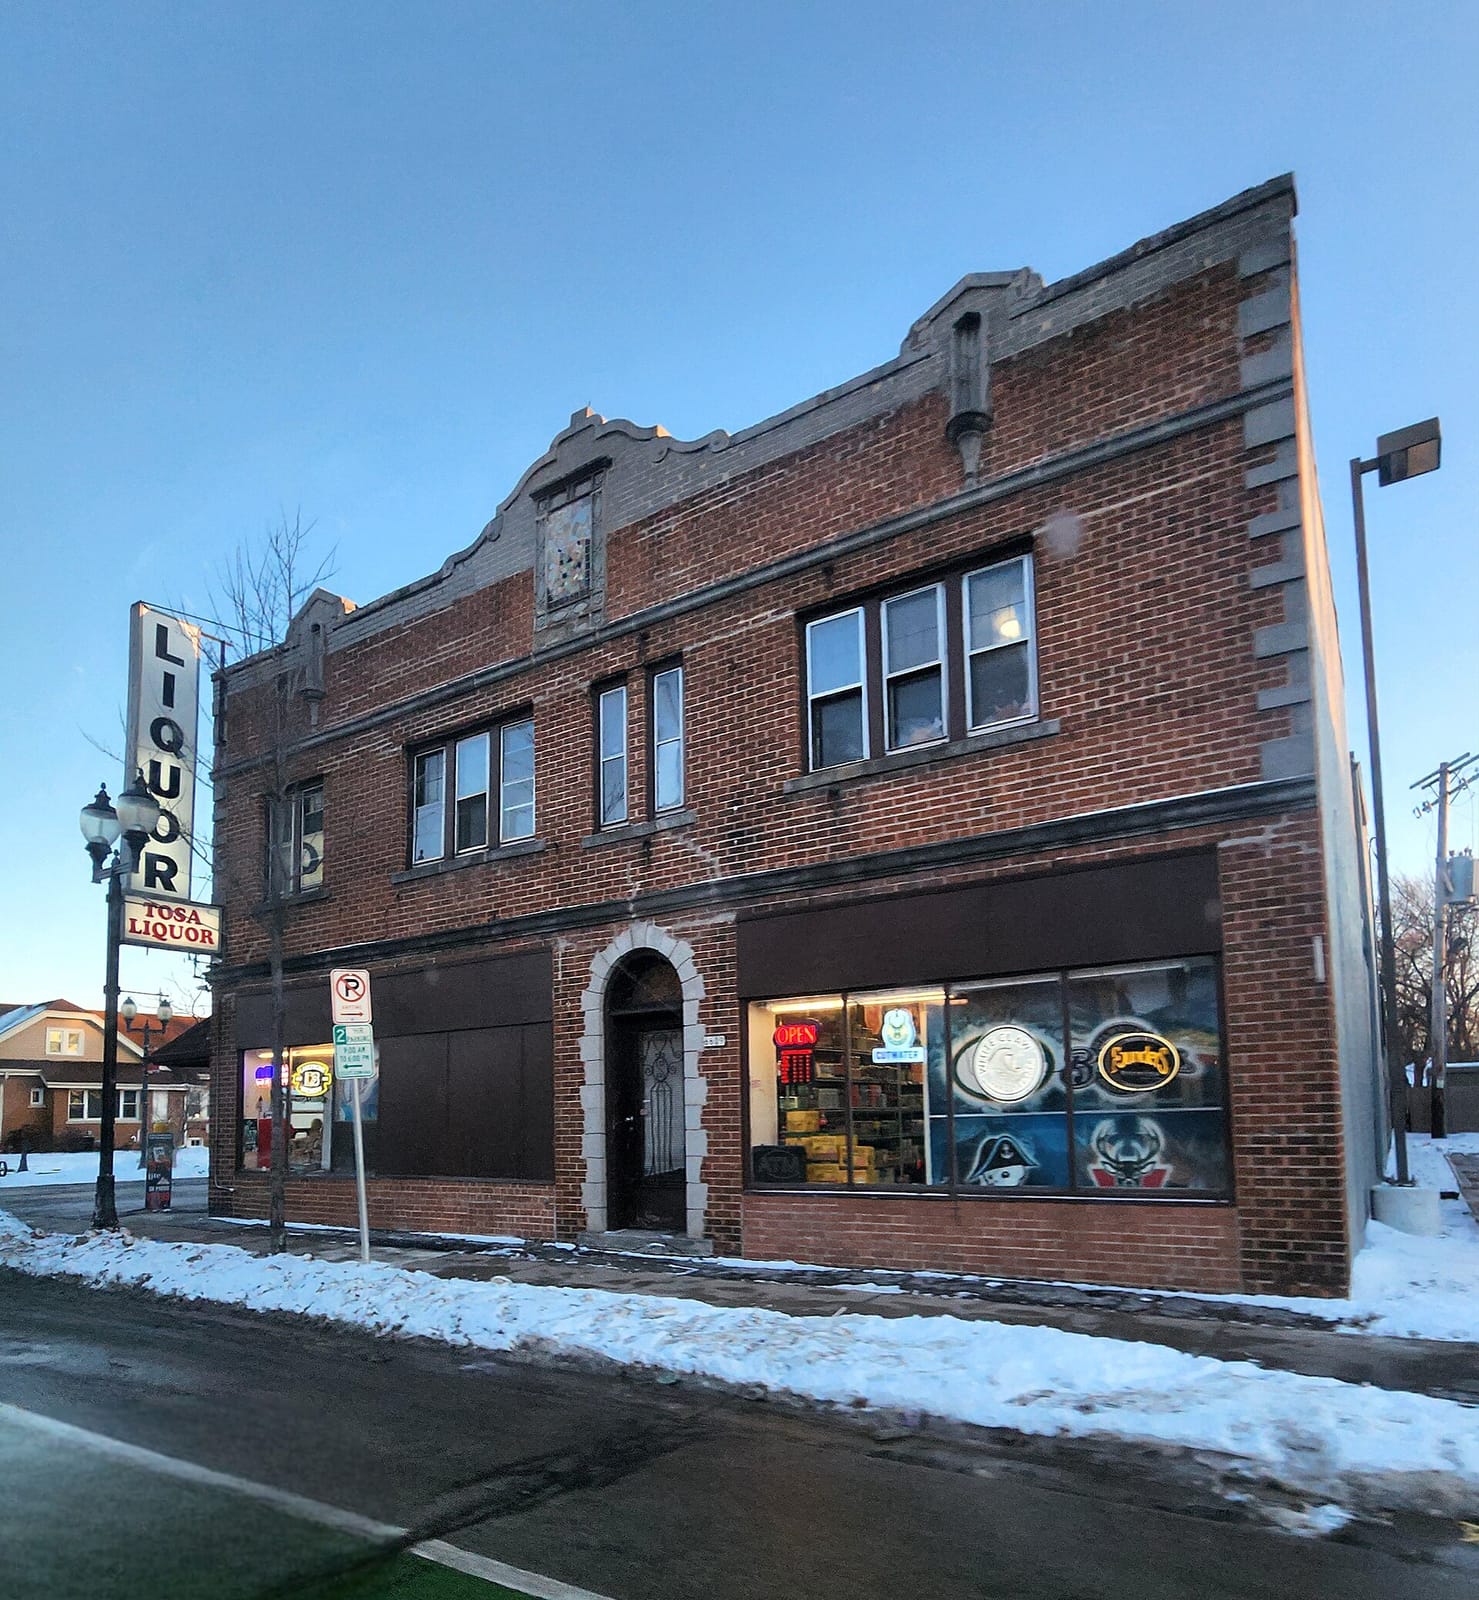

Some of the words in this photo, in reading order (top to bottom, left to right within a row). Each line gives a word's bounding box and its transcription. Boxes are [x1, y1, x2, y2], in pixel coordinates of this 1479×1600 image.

[144, 623, 184, 892] LIQUOR
[144, 902, 201, 925] TOSA
[128, 918, 215, 945] LIQUOR
[336, 1029, 345, 1042] 2
[776, 1026, 816, 1045] OPEN
